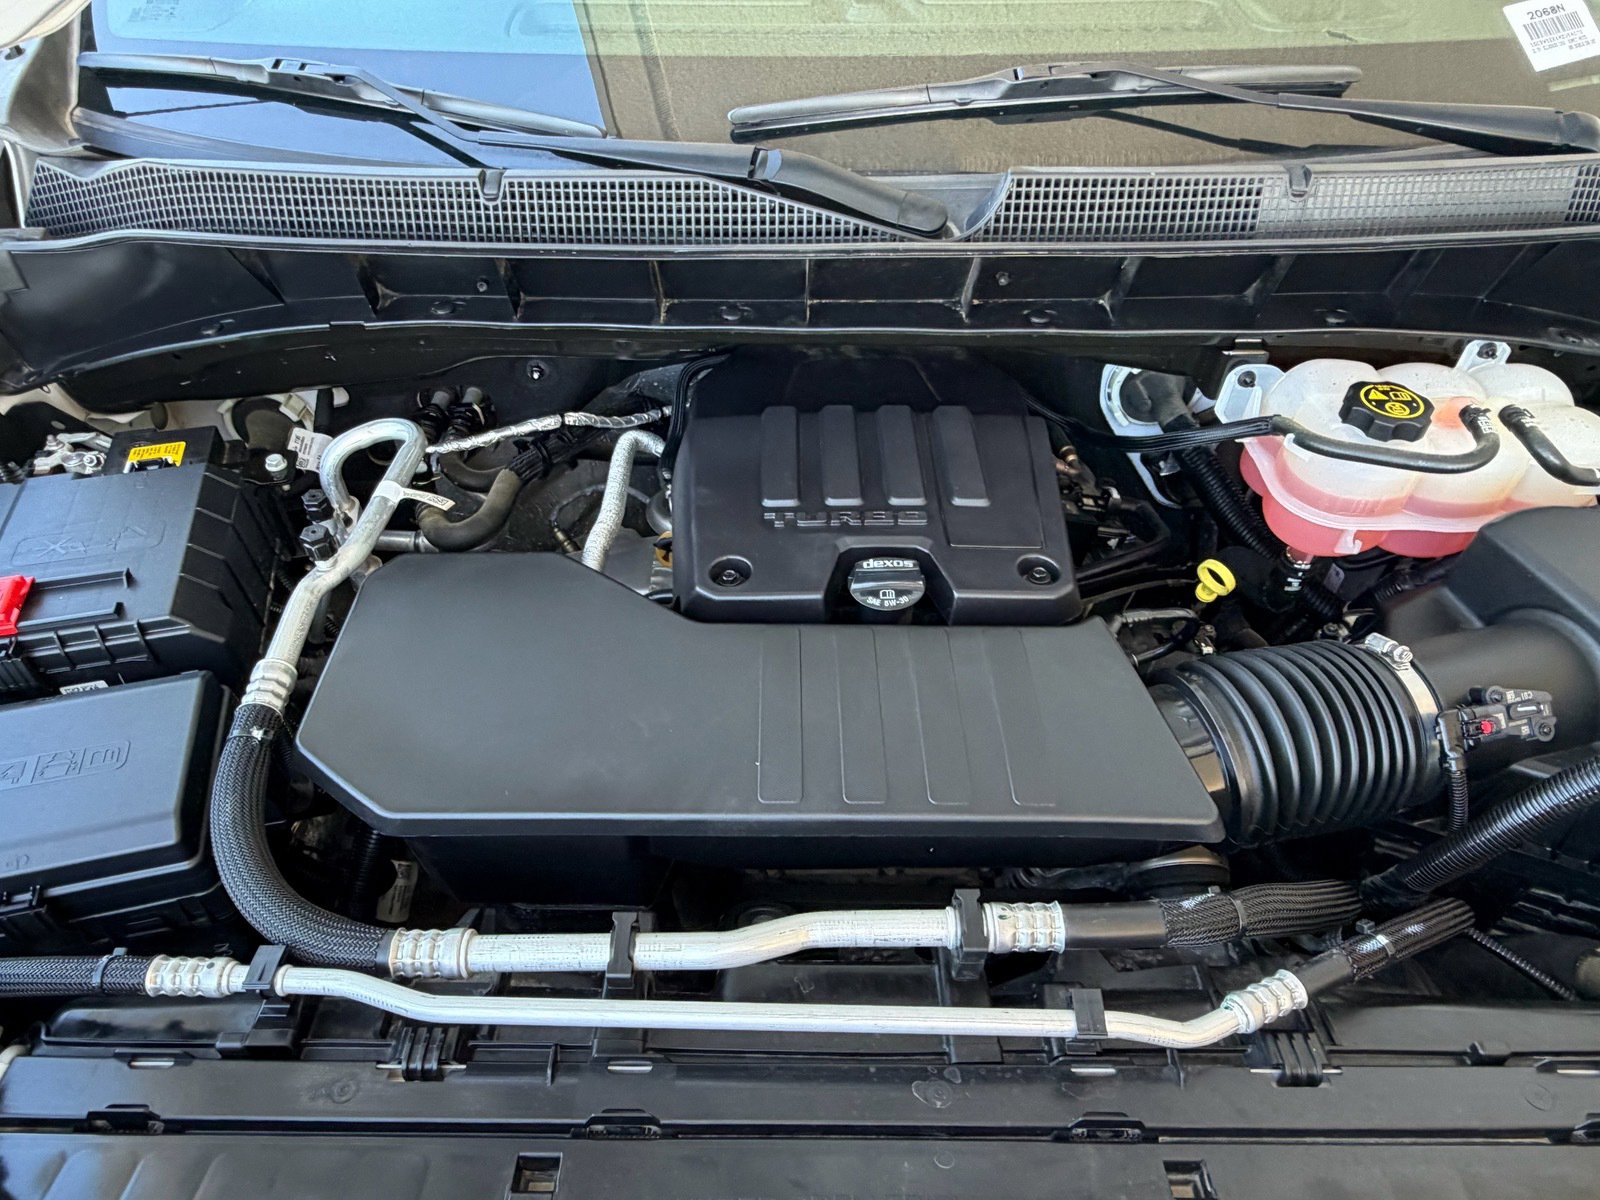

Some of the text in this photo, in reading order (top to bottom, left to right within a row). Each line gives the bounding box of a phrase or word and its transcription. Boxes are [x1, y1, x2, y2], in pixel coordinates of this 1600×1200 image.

[1528, 4, 1566, 20] 2068N
[863, 559, 914, 569] dexos
[866, 596, 882, 606] SAE
